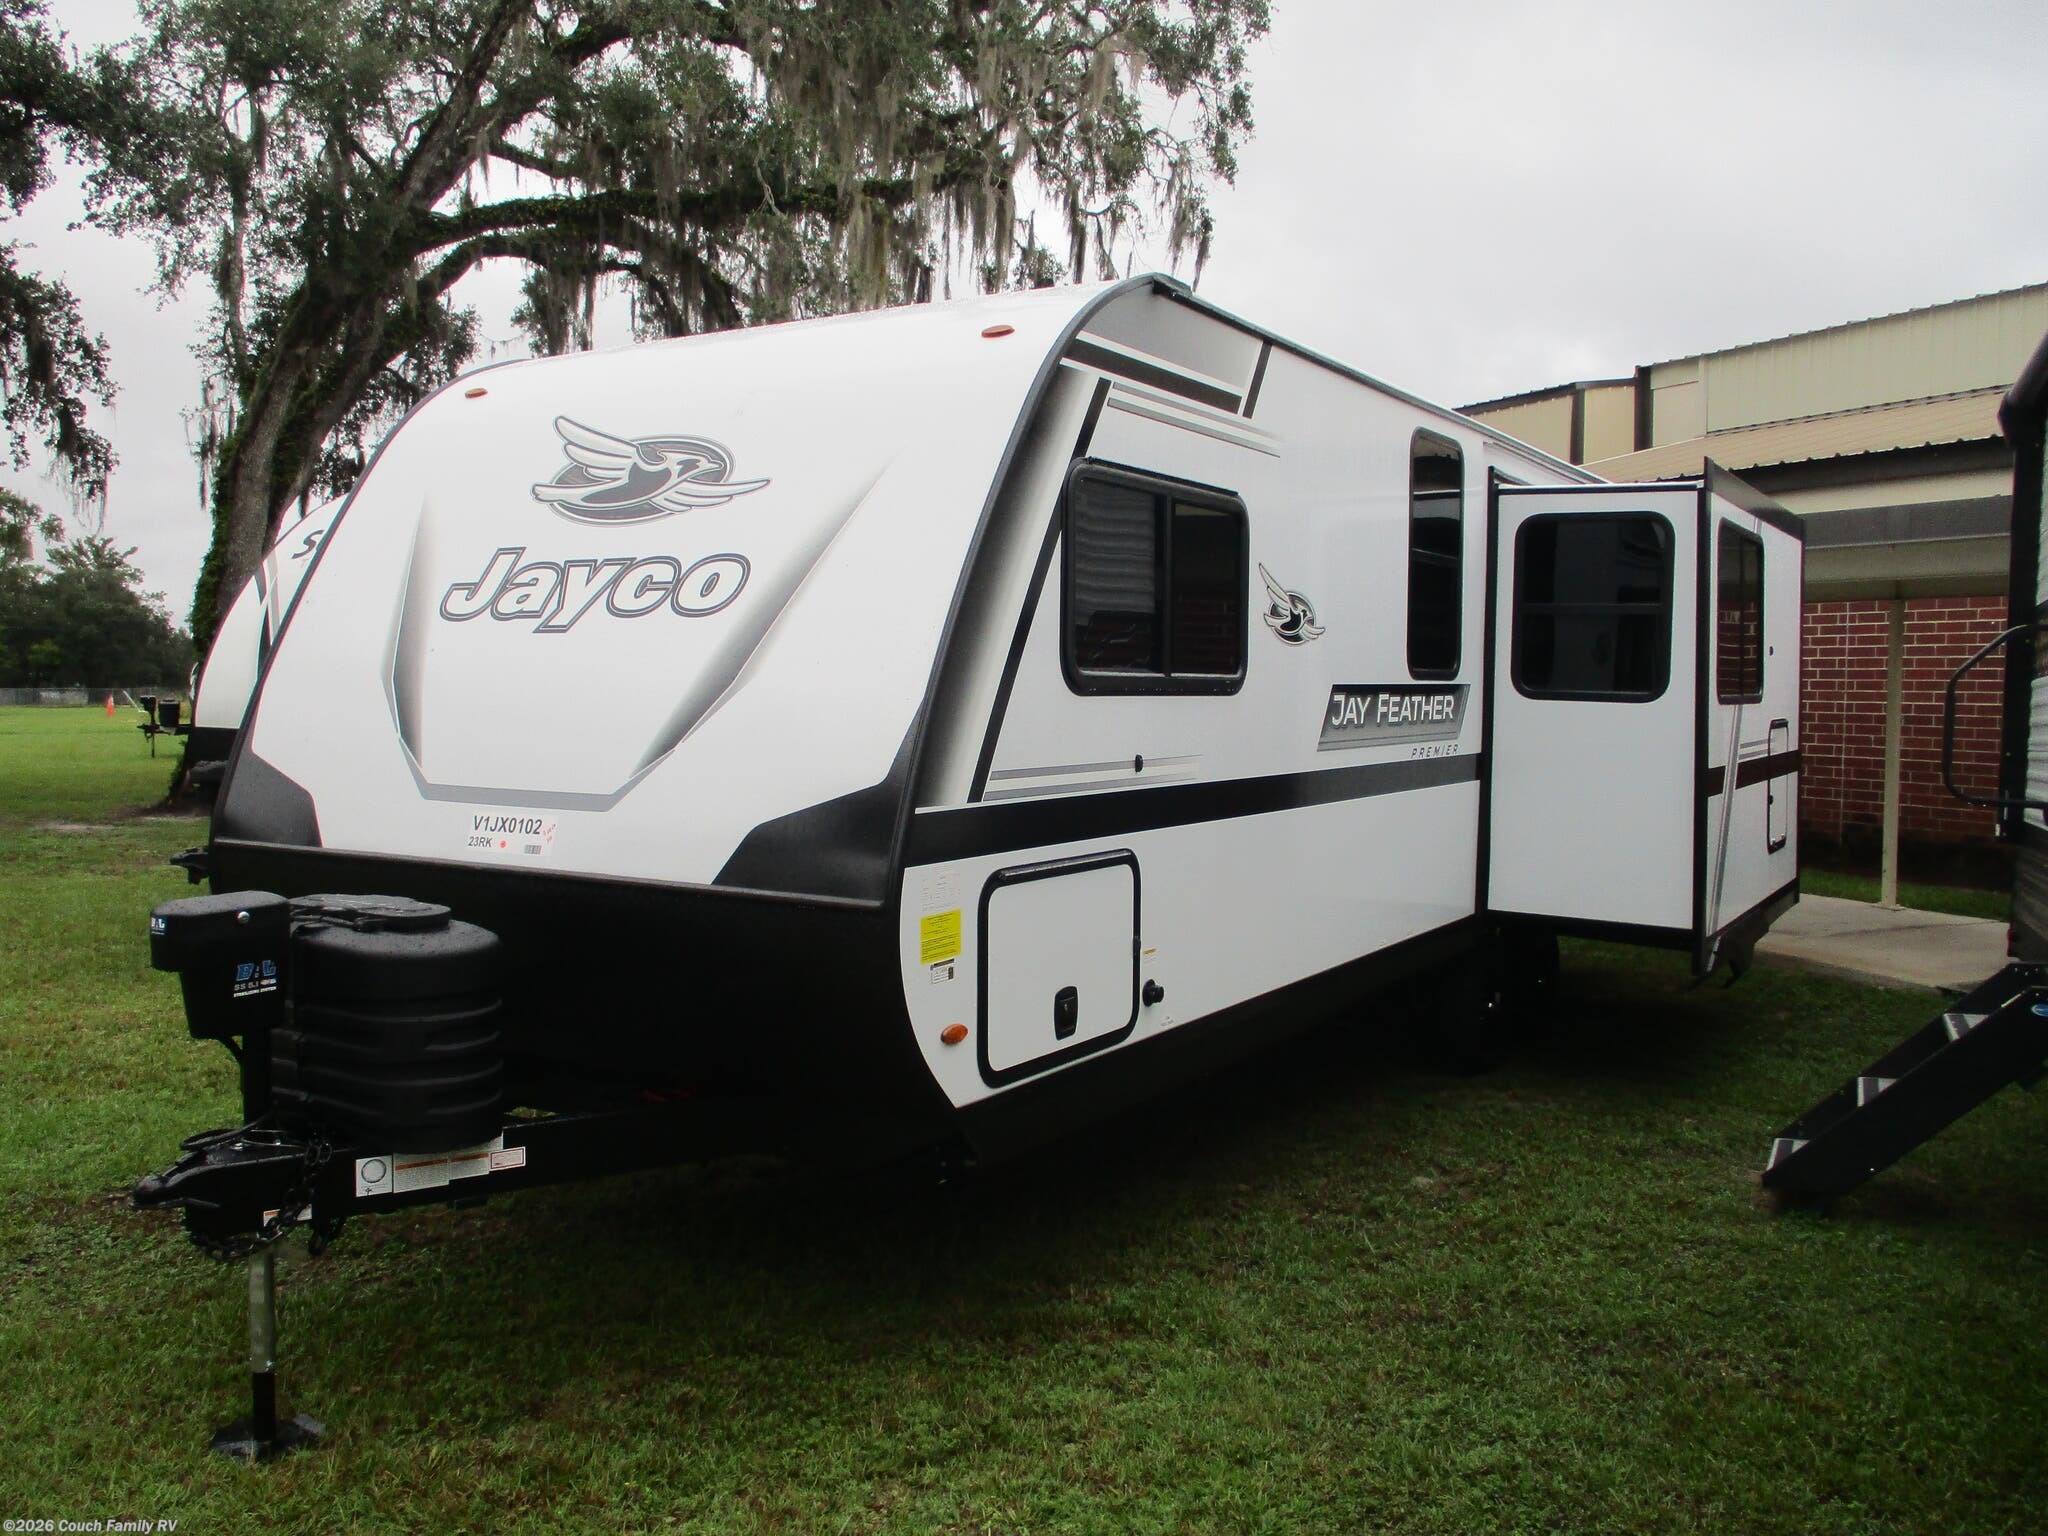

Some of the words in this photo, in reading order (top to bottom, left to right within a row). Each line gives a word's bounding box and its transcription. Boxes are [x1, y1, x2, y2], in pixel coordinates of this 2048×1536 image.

[439, 546, 751, 633] Jayco
[1331, 693, 1371, 726] JAY
[1376, 692, 1455, 724] FEATHER
[1411, 744, 1459, 759] PREMIER
[473, 815, 543, 835] V1JX0102
[467, 836, 494, 848] 23RK
